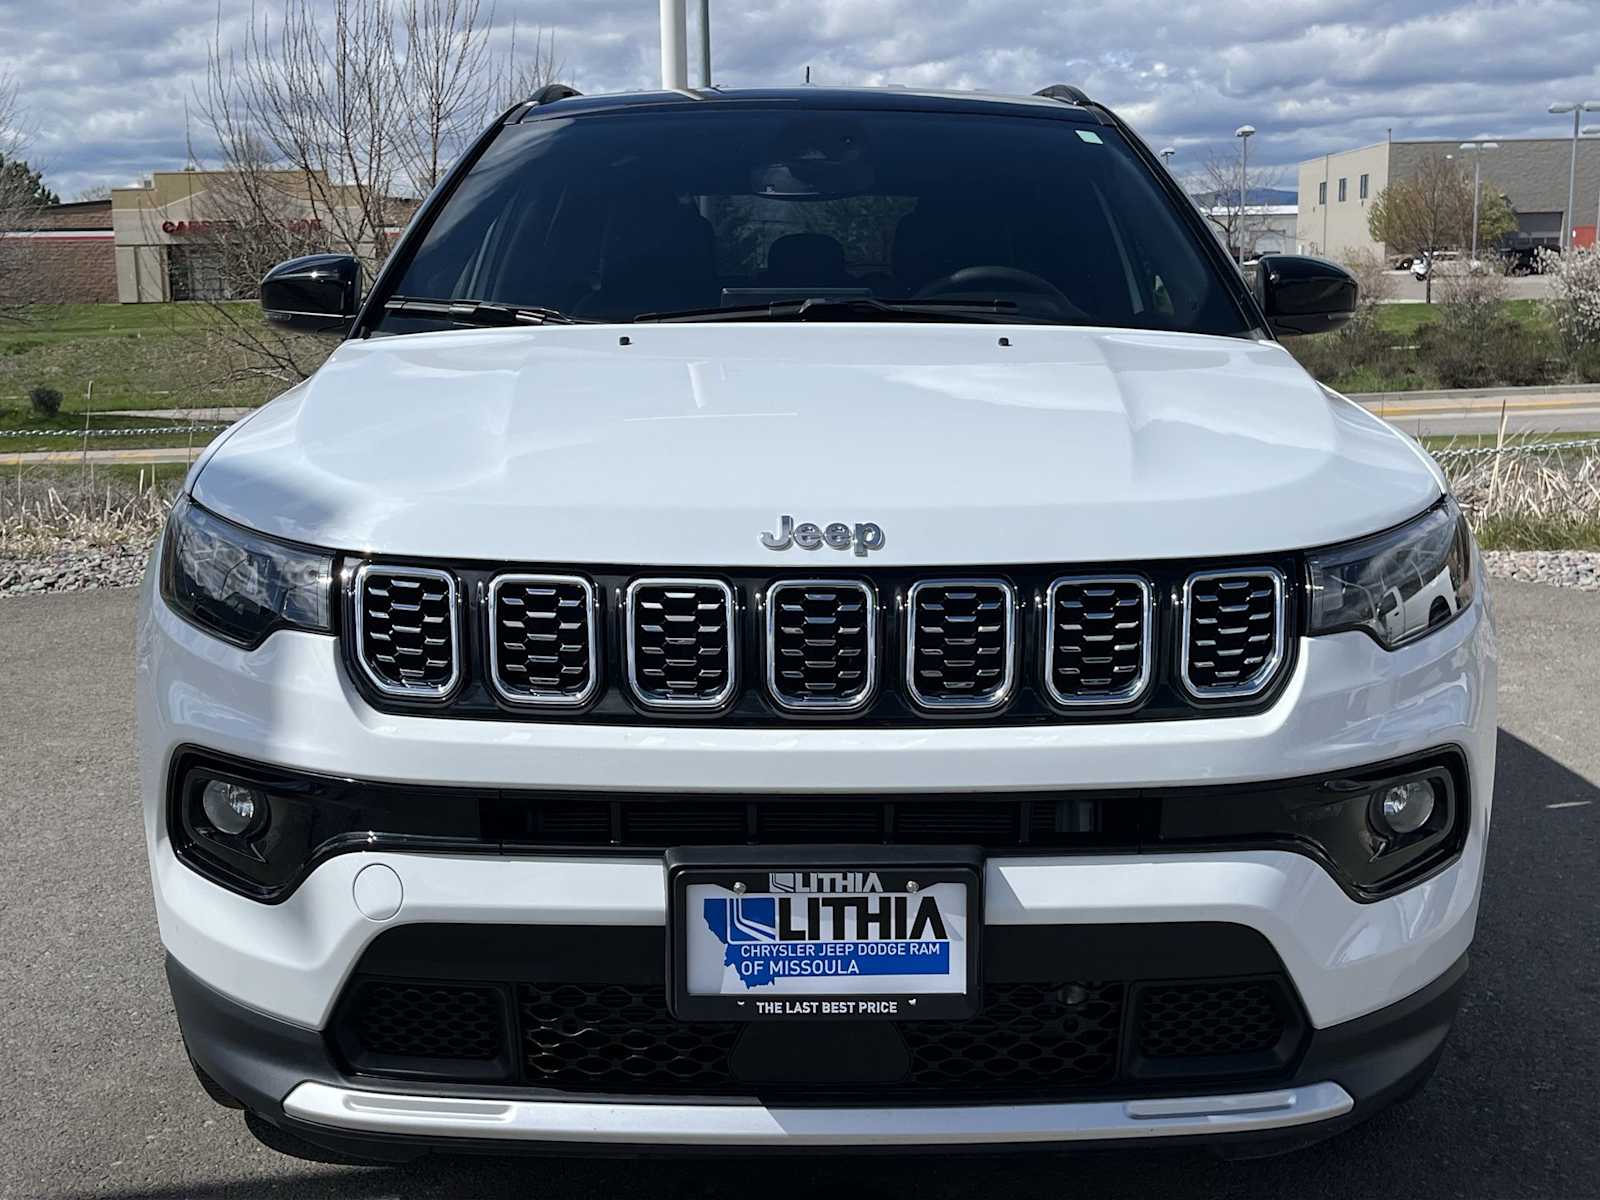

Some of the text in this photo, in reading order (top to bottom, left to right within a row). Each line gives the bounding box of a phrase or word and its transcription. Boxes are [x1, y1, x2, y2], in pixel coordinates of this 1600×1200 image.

[760, 515, 886, 557] Jeep
[795, 871, 883, 893] LITHIA
[778, 896, 948, 941] LITHIA
[740, 943, 941, 957] CHRYSLER JEEP DODGE RAM
[741, 959, 860, 976] OF MISSOULA
[756, 1001, 898, 1014] THE LAST BEST PRICE
